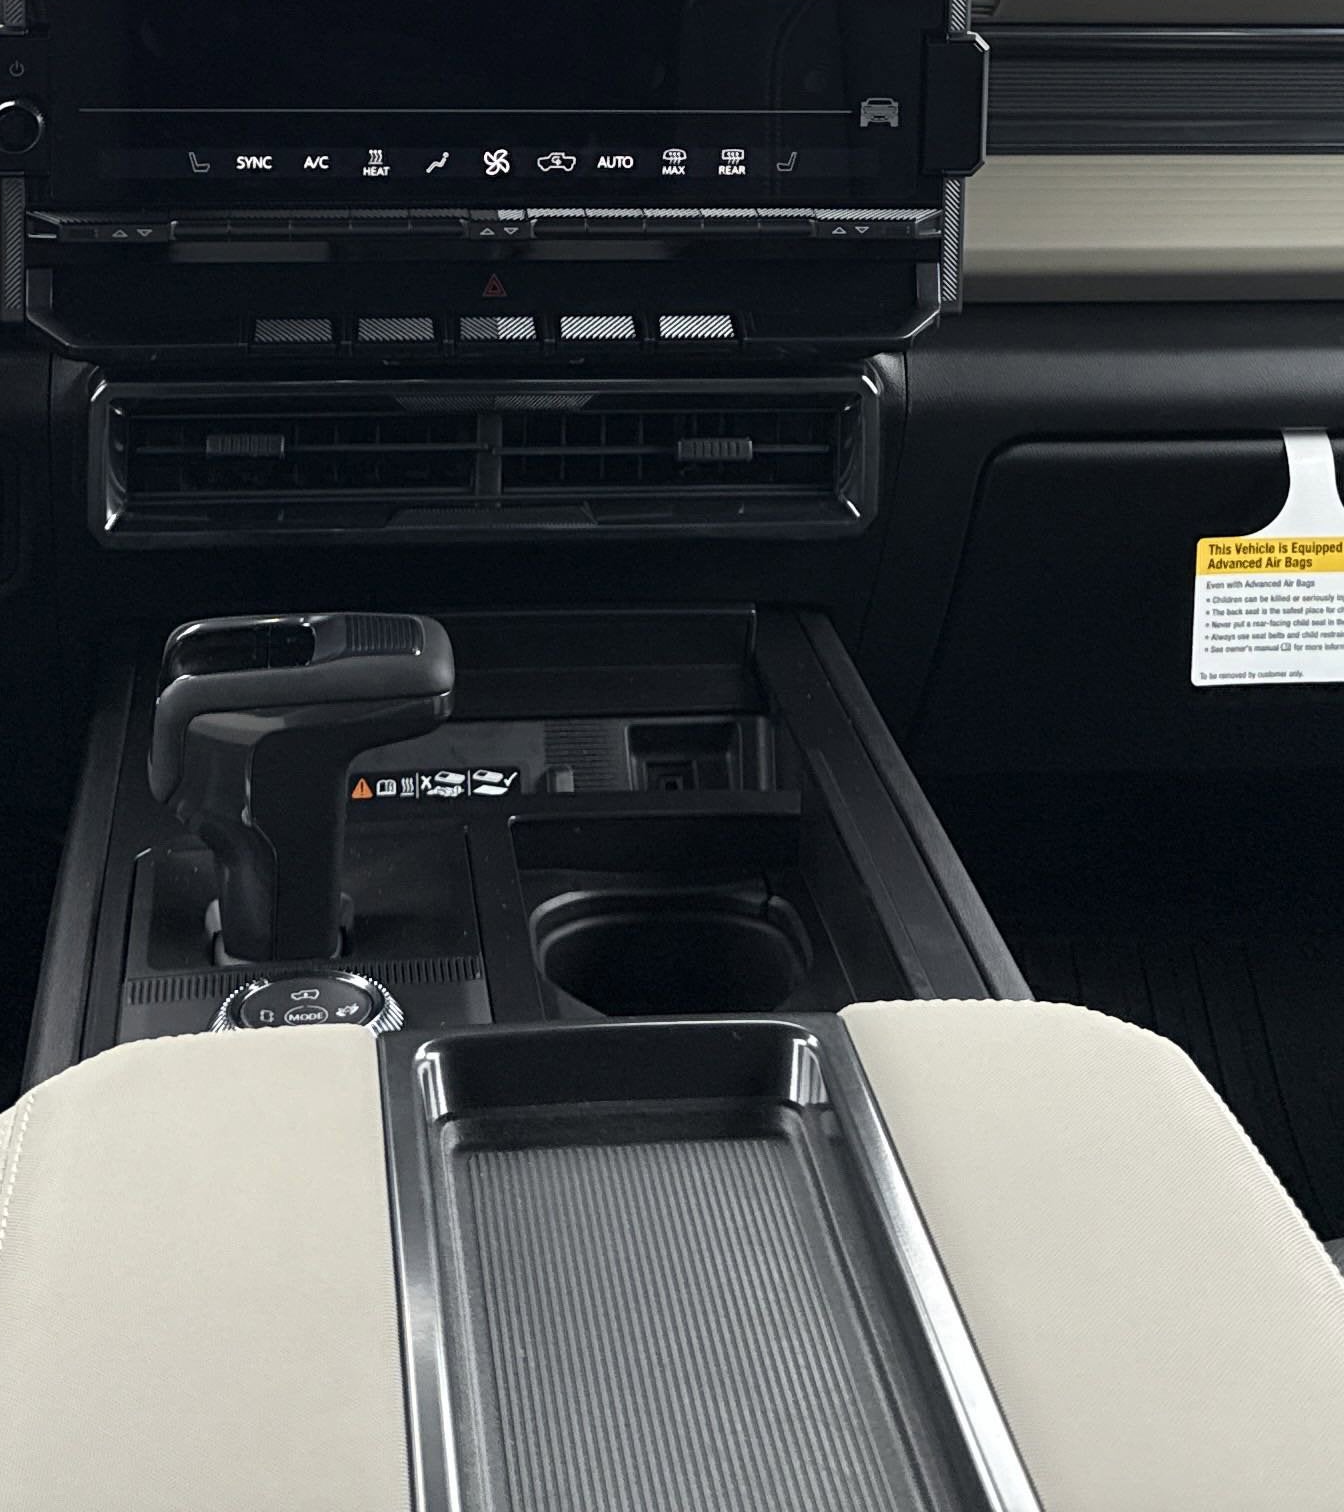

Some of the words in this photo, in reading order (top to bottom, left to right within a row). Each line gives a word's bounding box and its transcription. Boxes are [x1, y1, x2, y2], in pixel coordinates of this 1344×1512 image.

[237, 156, 272, 169] SYNC
[304, 156, 328, 169] A/C
[597, 156, 633, 168] AUTO
[363, 166, 390, 176] HEAT
[662, 166, 685, 175] MAX
[719, 165, 745, 175] REAR
[1208, 544, 1231, 555] This
[1235, 543, 1275, 554] Vehicle
[1279, 543, 1288, 553] is
[1292, 541, 1343, 555] Equipped
[1208, 558, 1262, 569] Advanced
[1265, 557, 1282, 568] Air
[1285, 557, 1312, 569] Bags
[1245, 580, 1281, 588] Advanced
[288, 1011, 324, 1021] MODE
